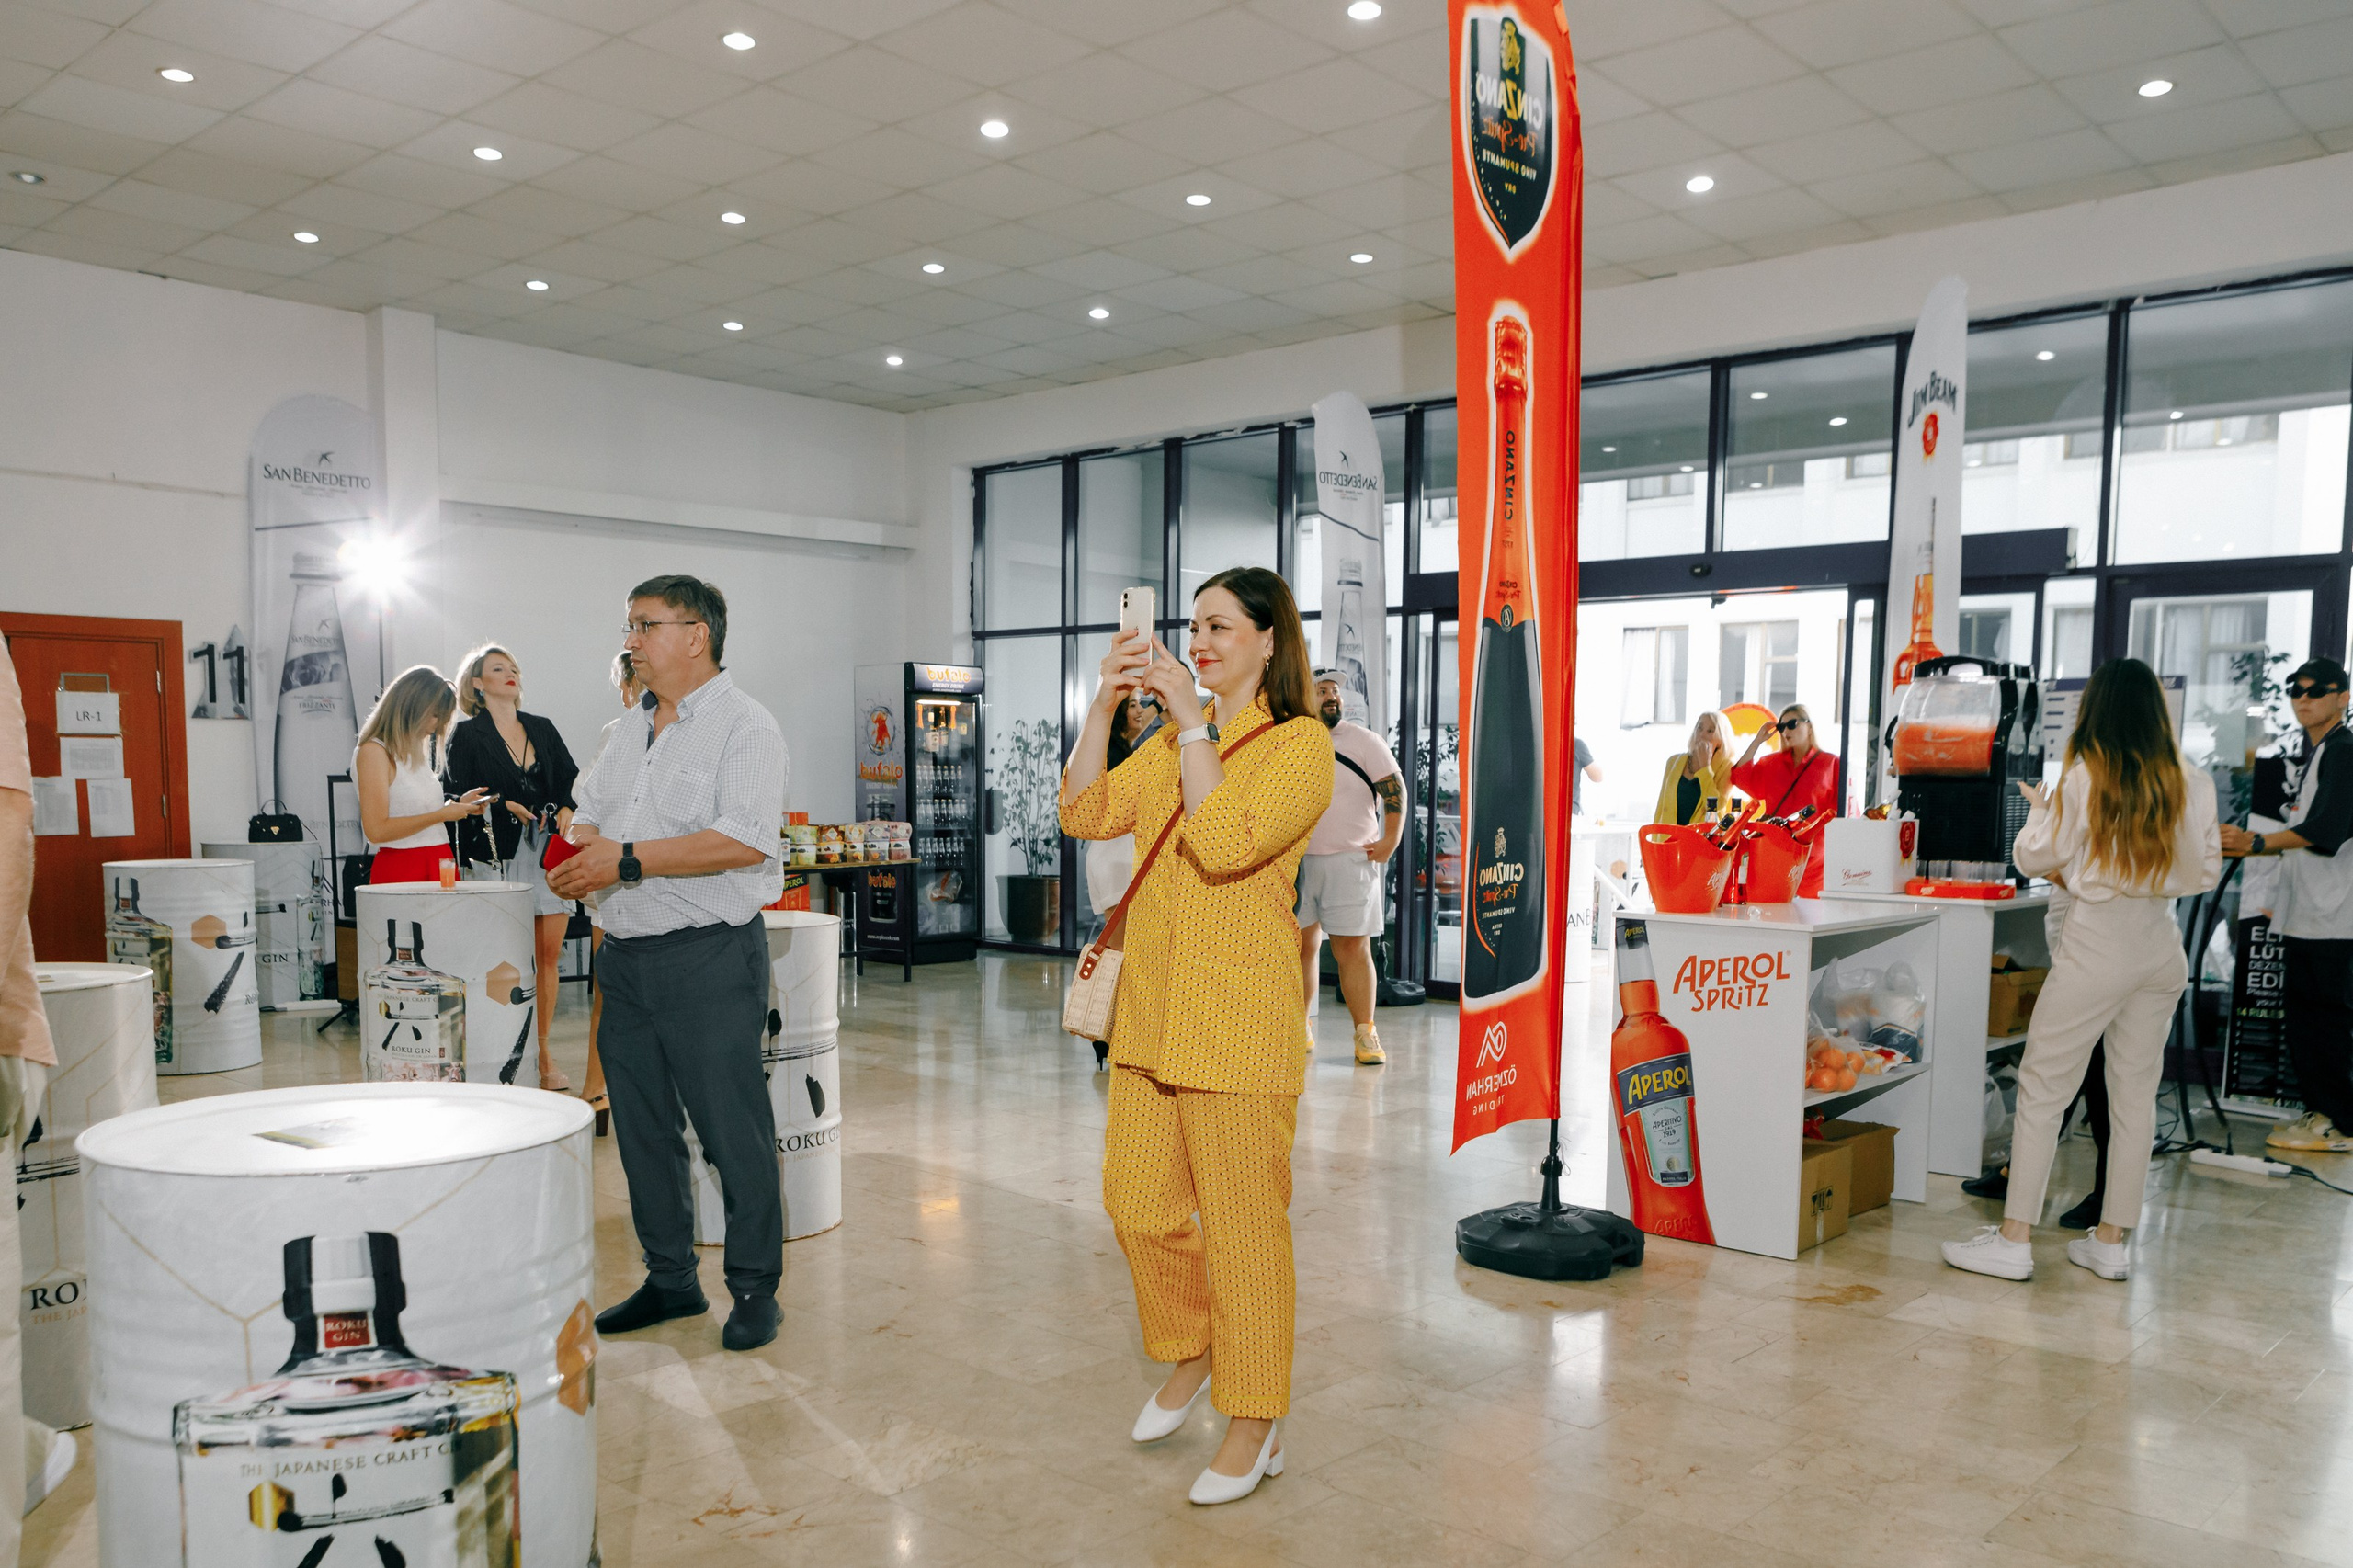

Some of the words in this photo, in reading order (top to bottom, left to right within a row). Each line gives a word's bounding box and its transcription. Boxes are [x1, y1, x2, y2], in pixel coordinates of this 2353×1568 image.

[193, 644, 245, 704] 11
[926, 666, 971, 683] bufalo
[76, 710, 102, 722] LR-1
[860, 760, 903, 780] bufalo
[868, 871, 896, 888] bufalo
[262, 954, 289, 964] GIN
[1673, 951, 1790, 994] APEROL
[1629, 1066, 1691, 1105] APEROL
[1653, 1115, 1682, 1130] APERITIVO
[775, 1131, 825, 1153] ROKU
[1663, 1130, 1677, 1139] 1919
[326, 1319, 367, 1332] ROKU
[332, 1331, 360, 1342] GIN
[275, 1456, 367, 1478] JAPANESE
[374, 1446, 431, 1466] CRAFT
